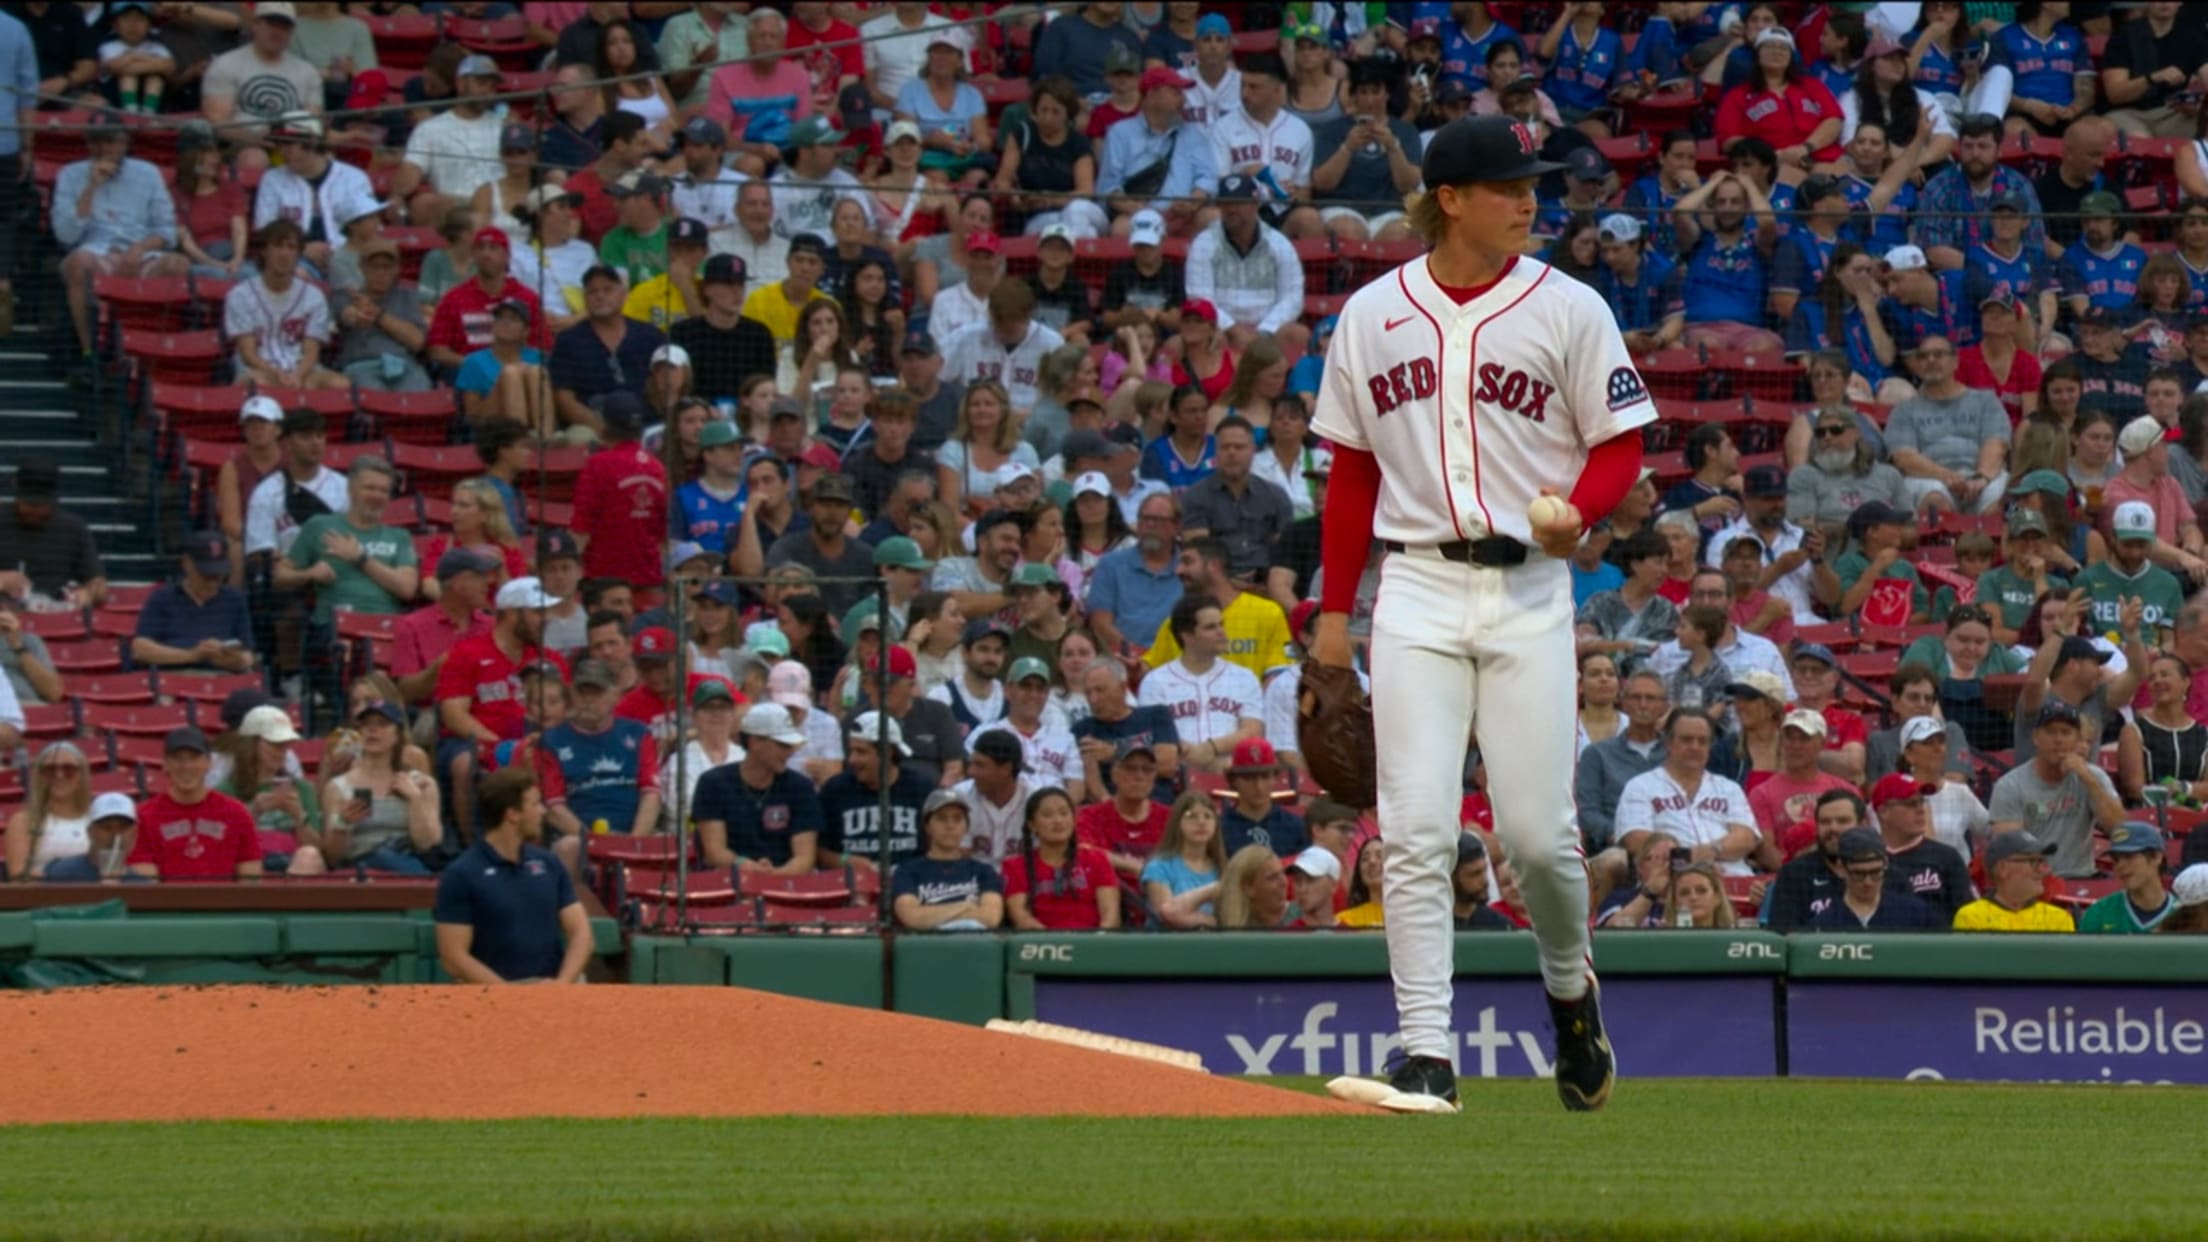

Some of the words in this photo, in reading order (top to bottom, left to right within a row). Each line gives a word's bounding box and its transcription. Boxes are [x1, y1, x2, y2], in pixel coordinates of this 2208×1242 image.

[1368, 356, 1437, 418] RED
[1475, 362, 1556, 423] SOX
[1209, 696, 1243, 718] SOX
[1225, 1002, 1558, 1077] xfint
[1975, 1006, 2204, 1055] Reliable
